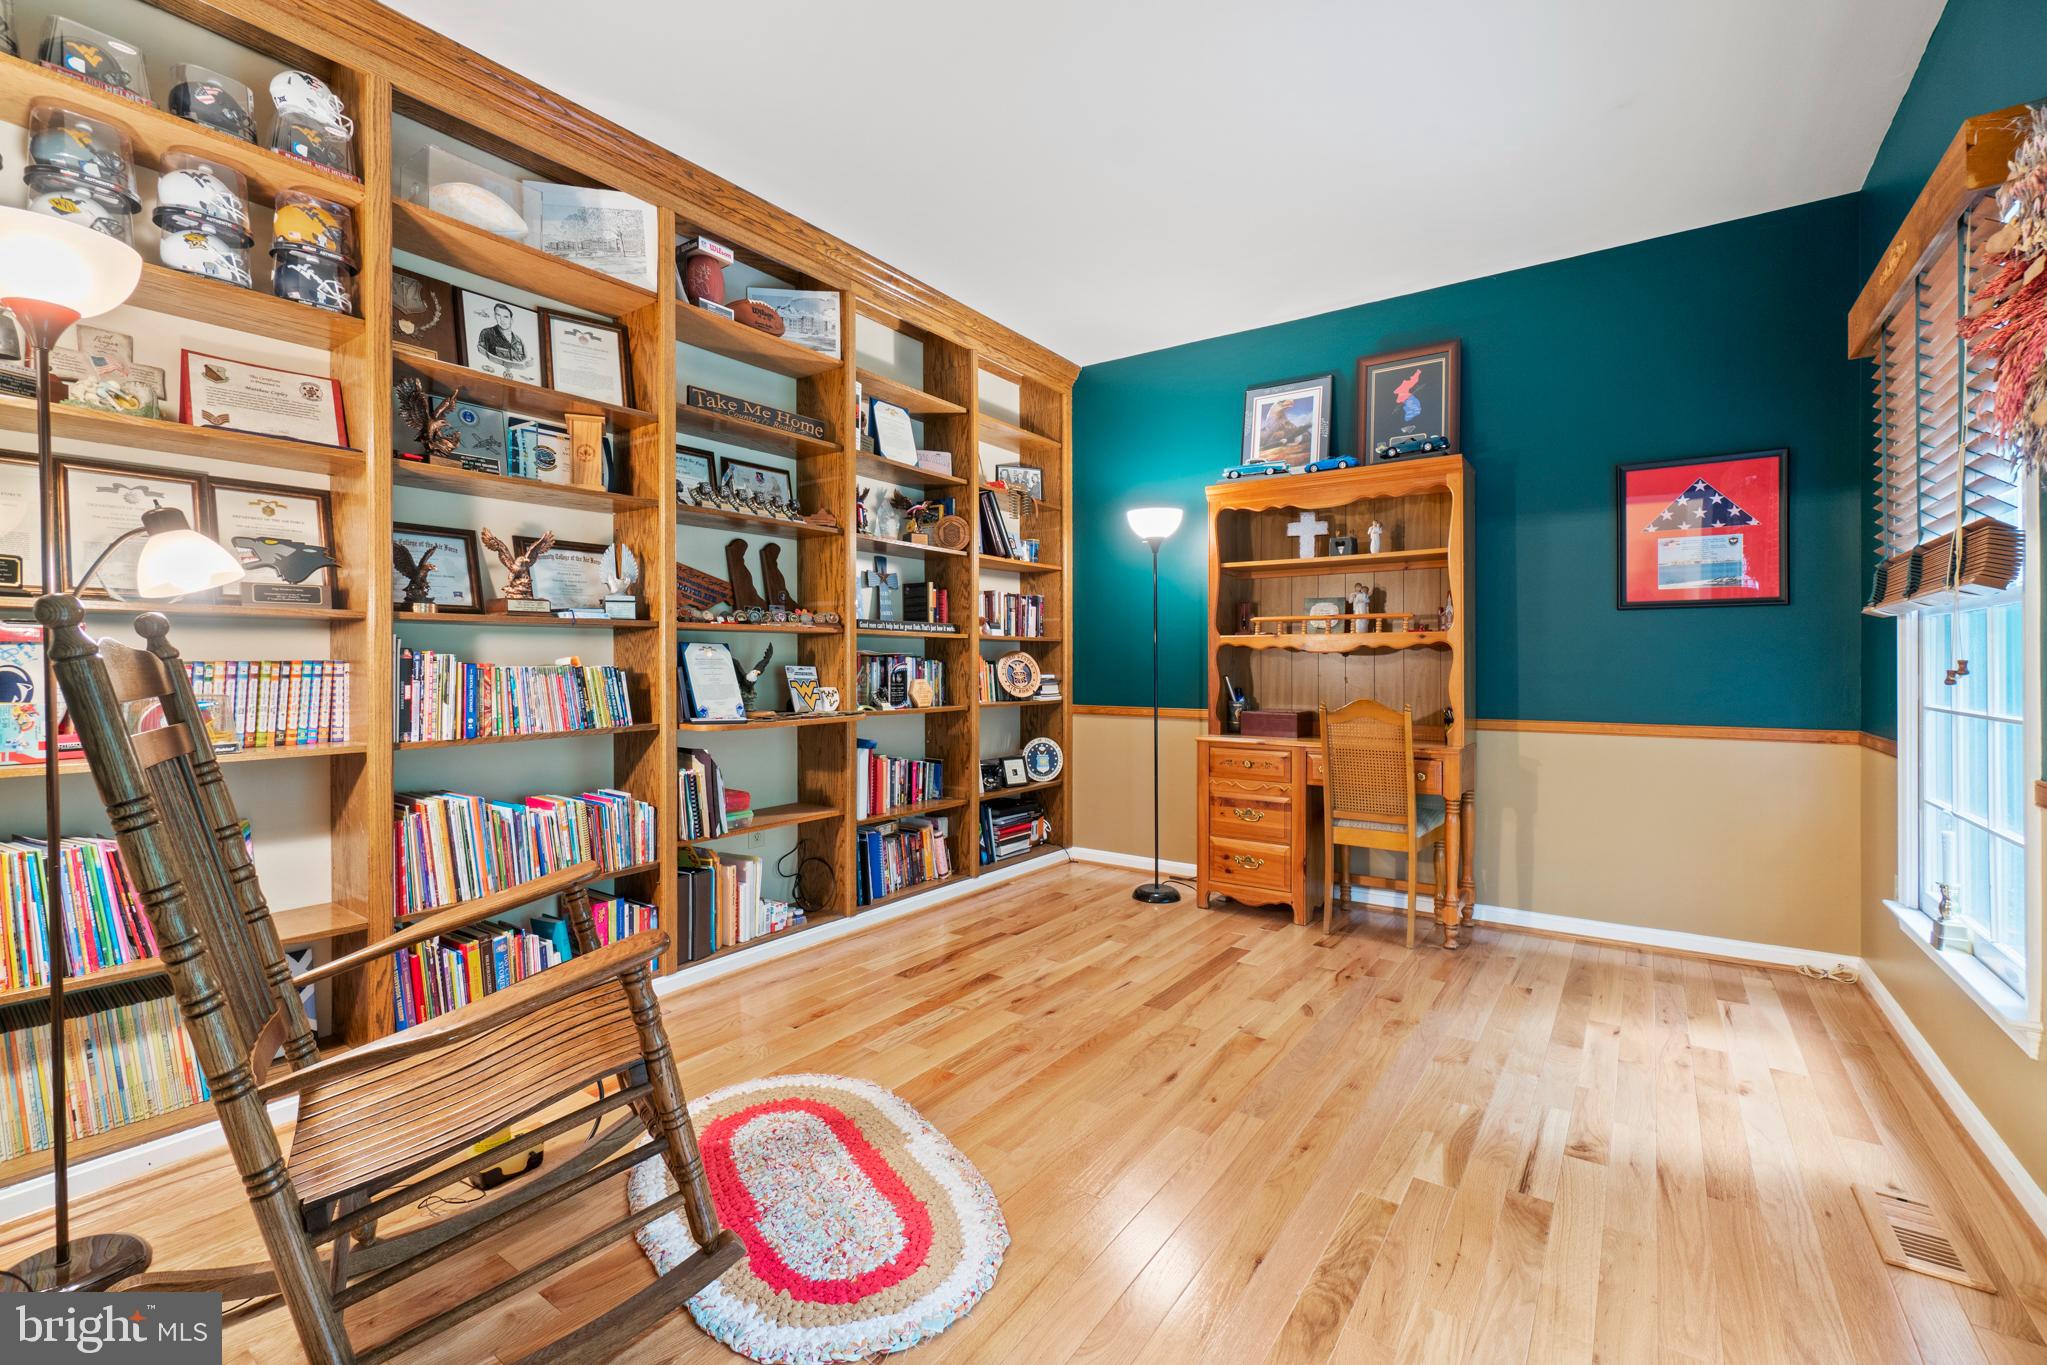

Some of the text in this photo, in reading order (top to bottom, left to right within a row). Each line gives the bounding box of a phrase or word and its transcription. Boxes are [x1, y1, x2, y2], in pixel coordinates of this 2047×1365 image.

[105, 85, 147, 106] HELMET
[709, 244, 732, 259] Wilson
[752, 306, 774, 320] Wilson
[692, 388, 824, 438] Take Me Home
[728, 410, 796, 432] Country Roads
